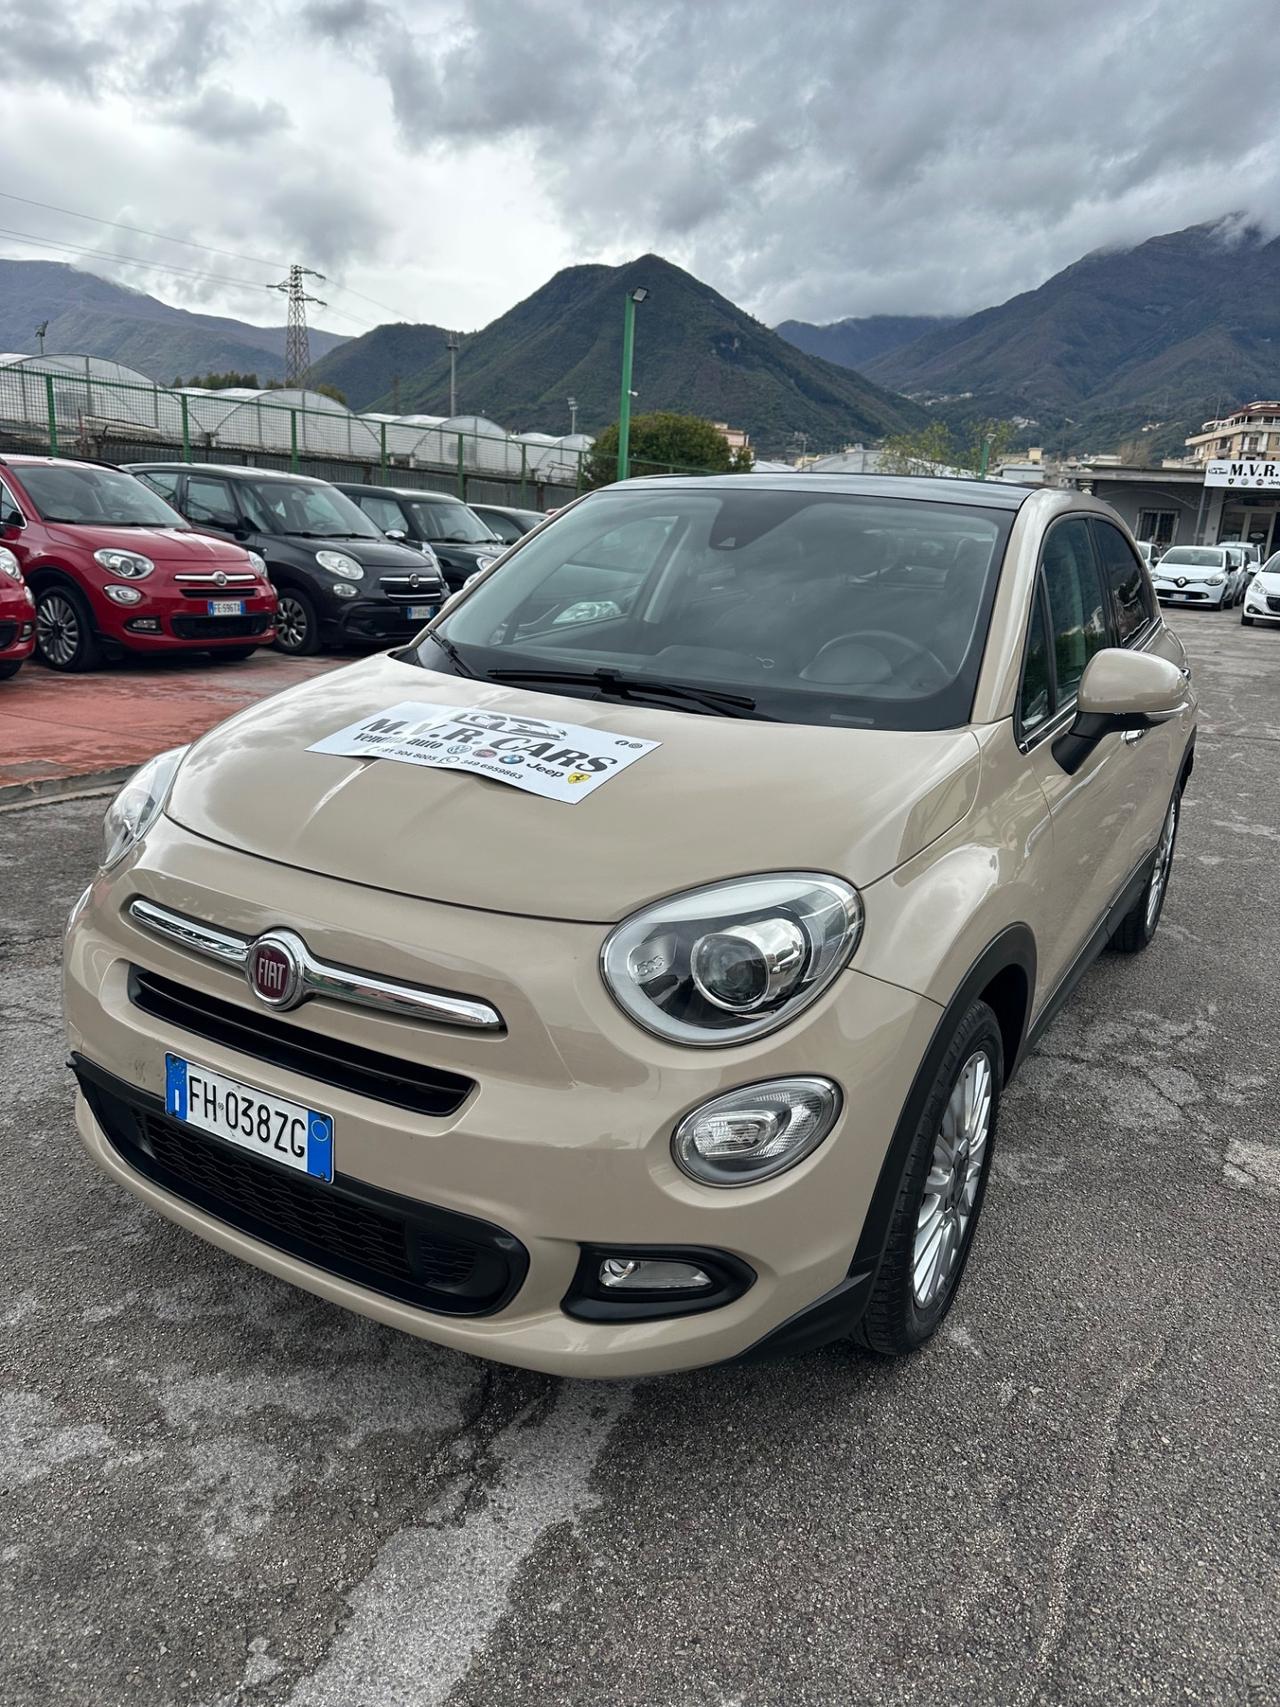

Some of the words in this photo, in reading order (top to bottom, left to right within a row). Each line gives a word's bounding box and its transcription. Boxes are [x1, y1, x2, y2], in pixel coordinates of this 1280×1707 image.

[406, 738, 444, 750] auto
[489, 737, 618, 773] CARS
[480, 763, 523, 780] 6959863
[526, 763, 564, 778] Jeep
[258, 957, 286, 990] FIAT
